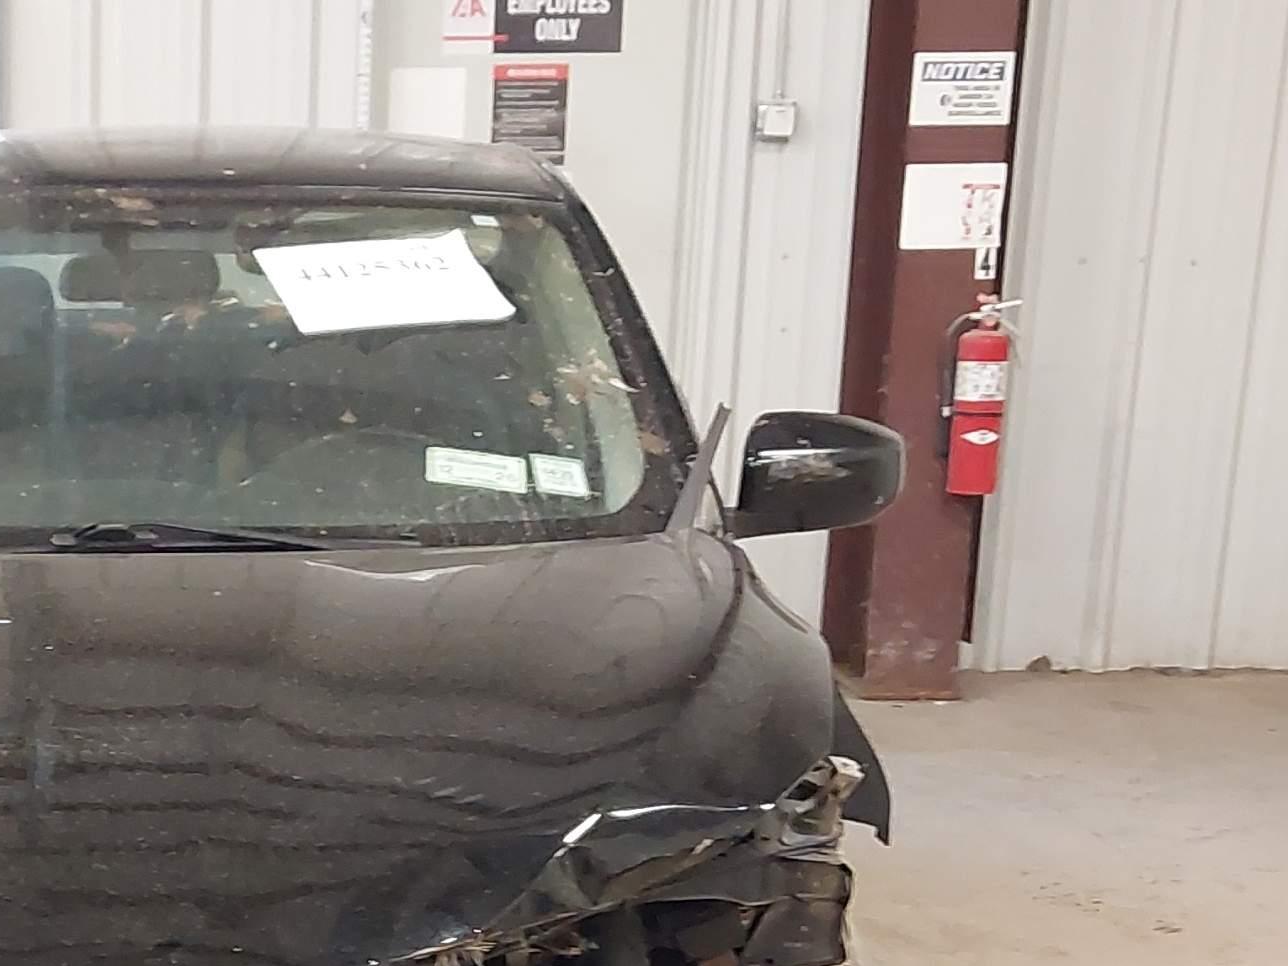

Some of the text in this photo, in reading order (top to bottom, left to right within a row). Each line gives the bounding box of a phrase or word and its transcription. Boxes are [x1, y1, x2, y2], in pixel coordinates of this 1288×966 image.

[535, 18, 581, 41] ONLY
[923, 62, 1005, 81] NOTICE
[980, 248, 994, 277] 4
